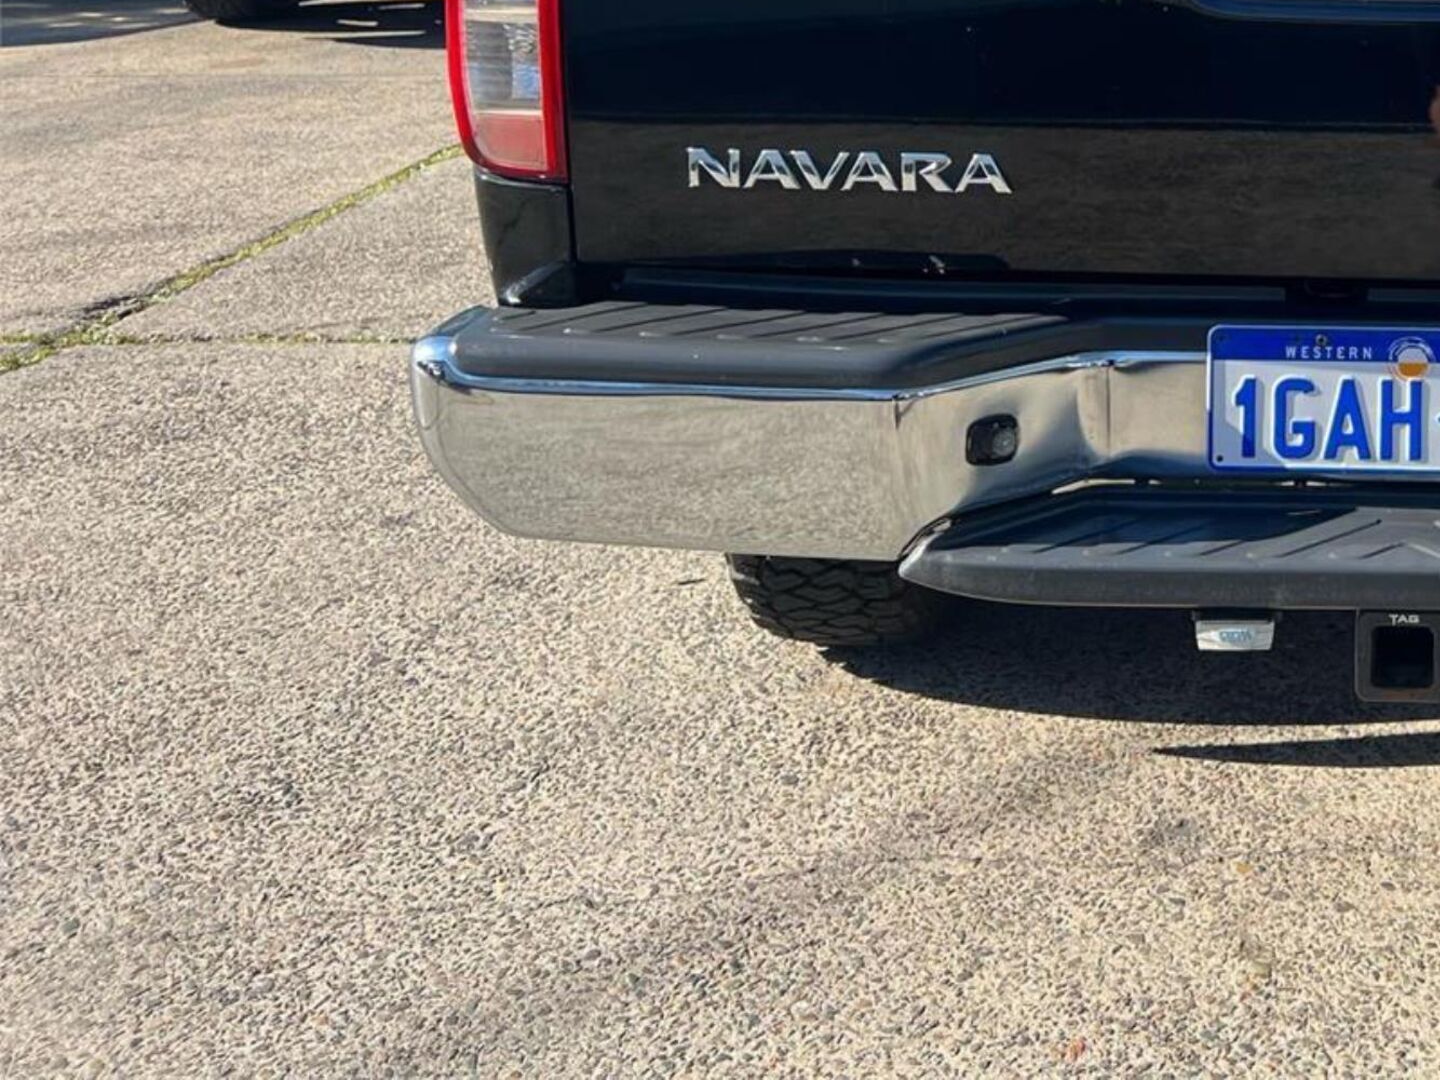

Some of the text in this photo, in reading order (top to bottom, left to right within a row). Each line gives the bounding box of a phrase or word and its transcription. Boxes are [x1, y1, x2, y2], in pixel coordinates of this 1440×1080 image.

[687, 147, 1012, 194] NAVARA
[1285, 345, 1373, 360] WESTERN
[1389, 614, 1419, 626] TAG
